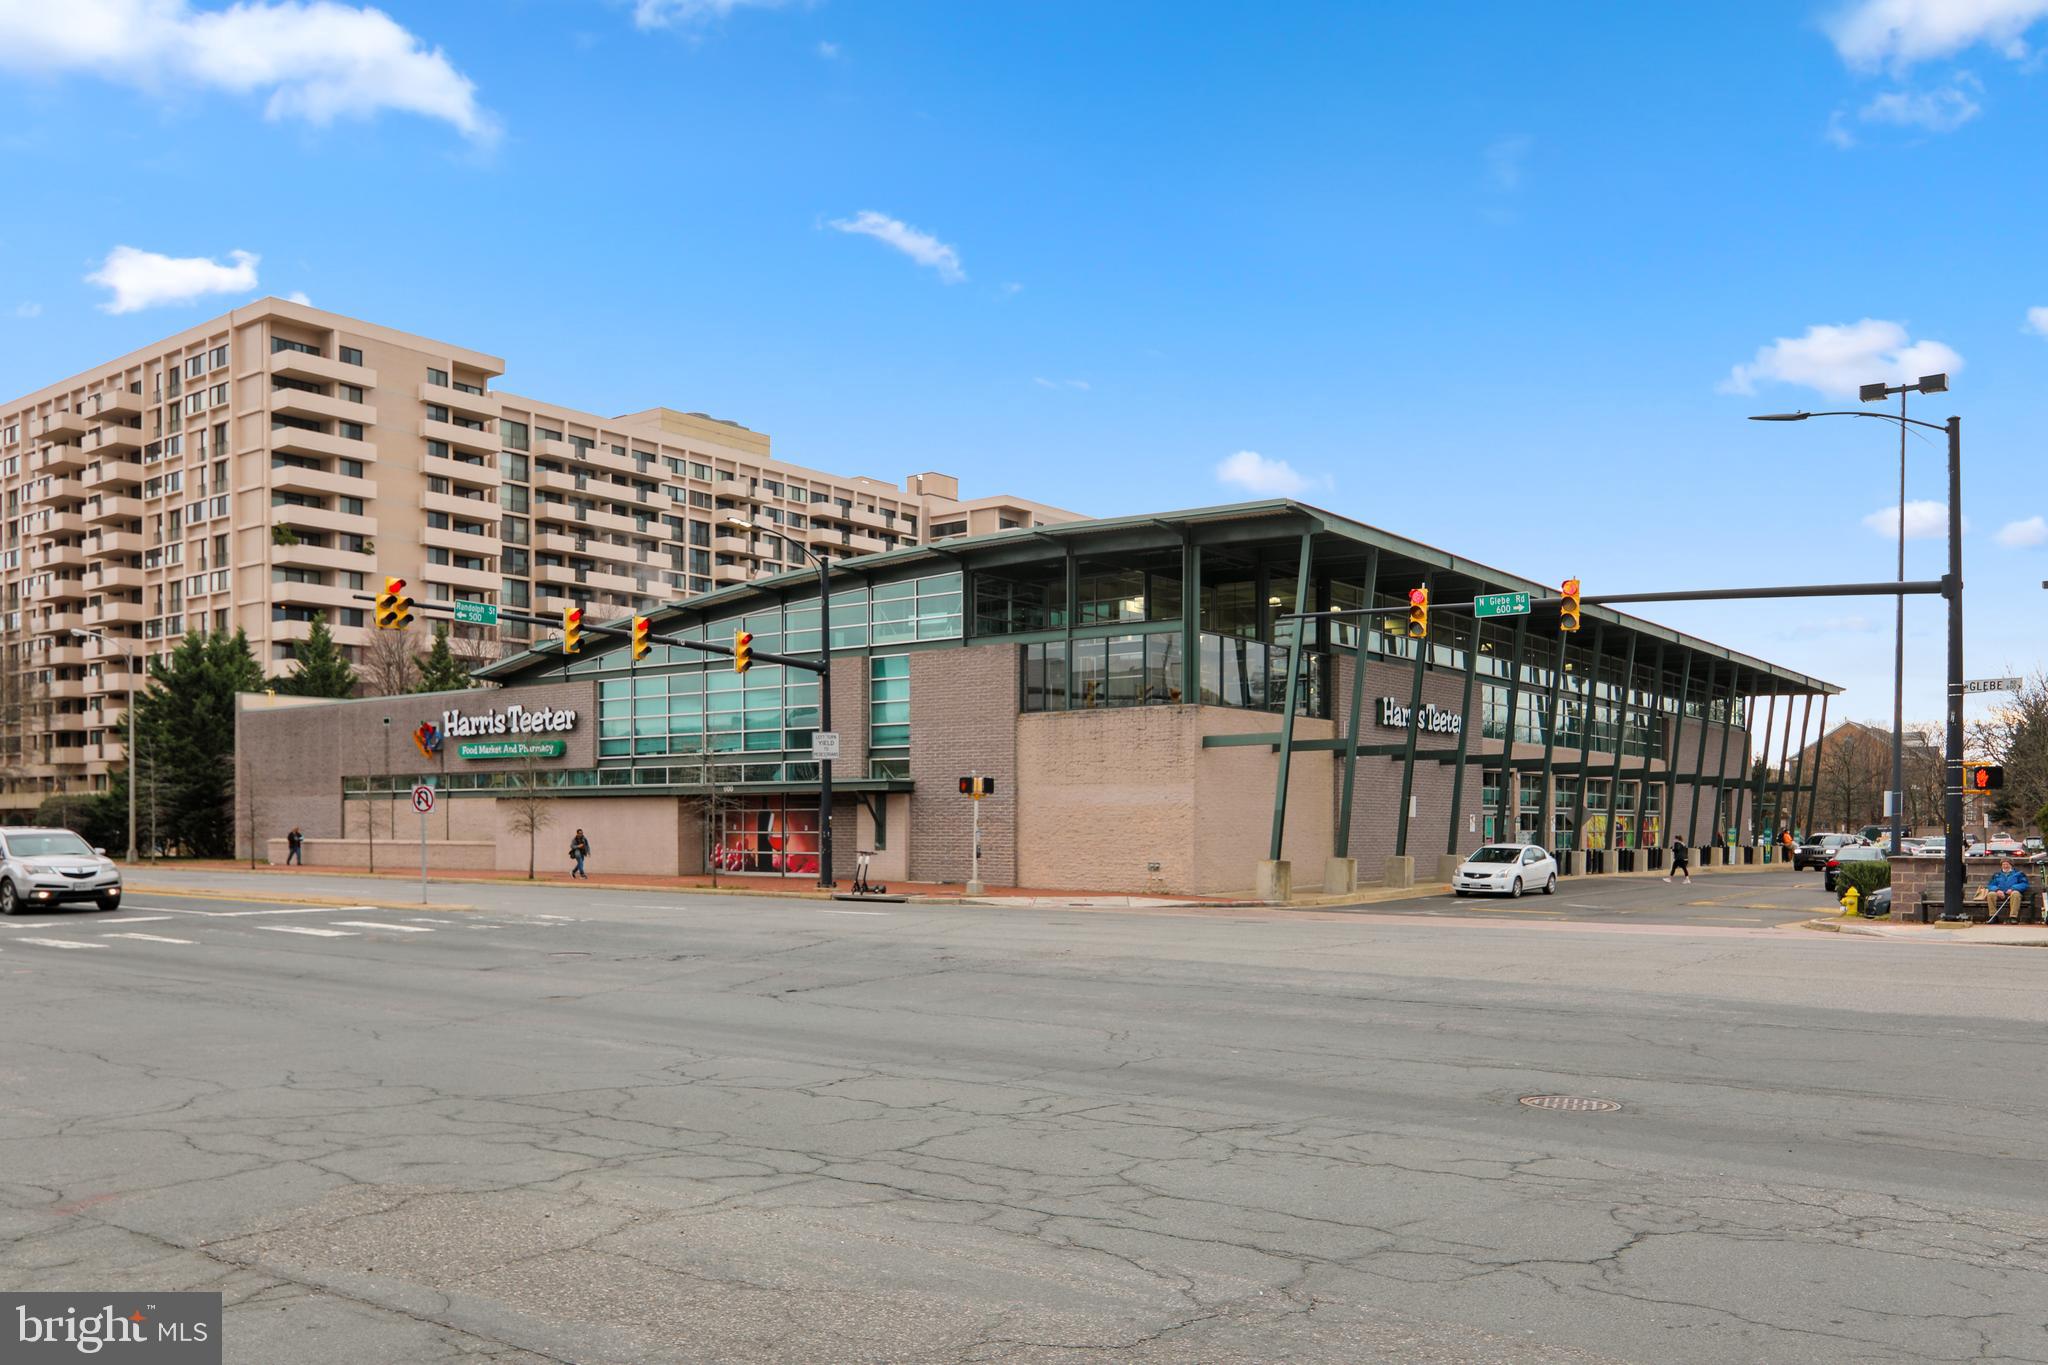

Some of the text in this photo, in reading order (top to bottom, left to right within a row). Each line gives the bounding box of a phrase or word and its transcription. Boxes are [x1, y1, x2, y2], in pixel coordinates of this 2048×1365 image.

[1479, 594, 1525, 607] N Glebe Rd
[456, 602, 496, 615] Randolph St
[1496, 605, 1511, 614] 600
[468, 612, 482, 622] 500
[1969, 681, 2003, 691] GLEBE
[443, 705, 576, 737] Harris Teeter
[462, 743, 554, 755] Food Market And Pharmacy
